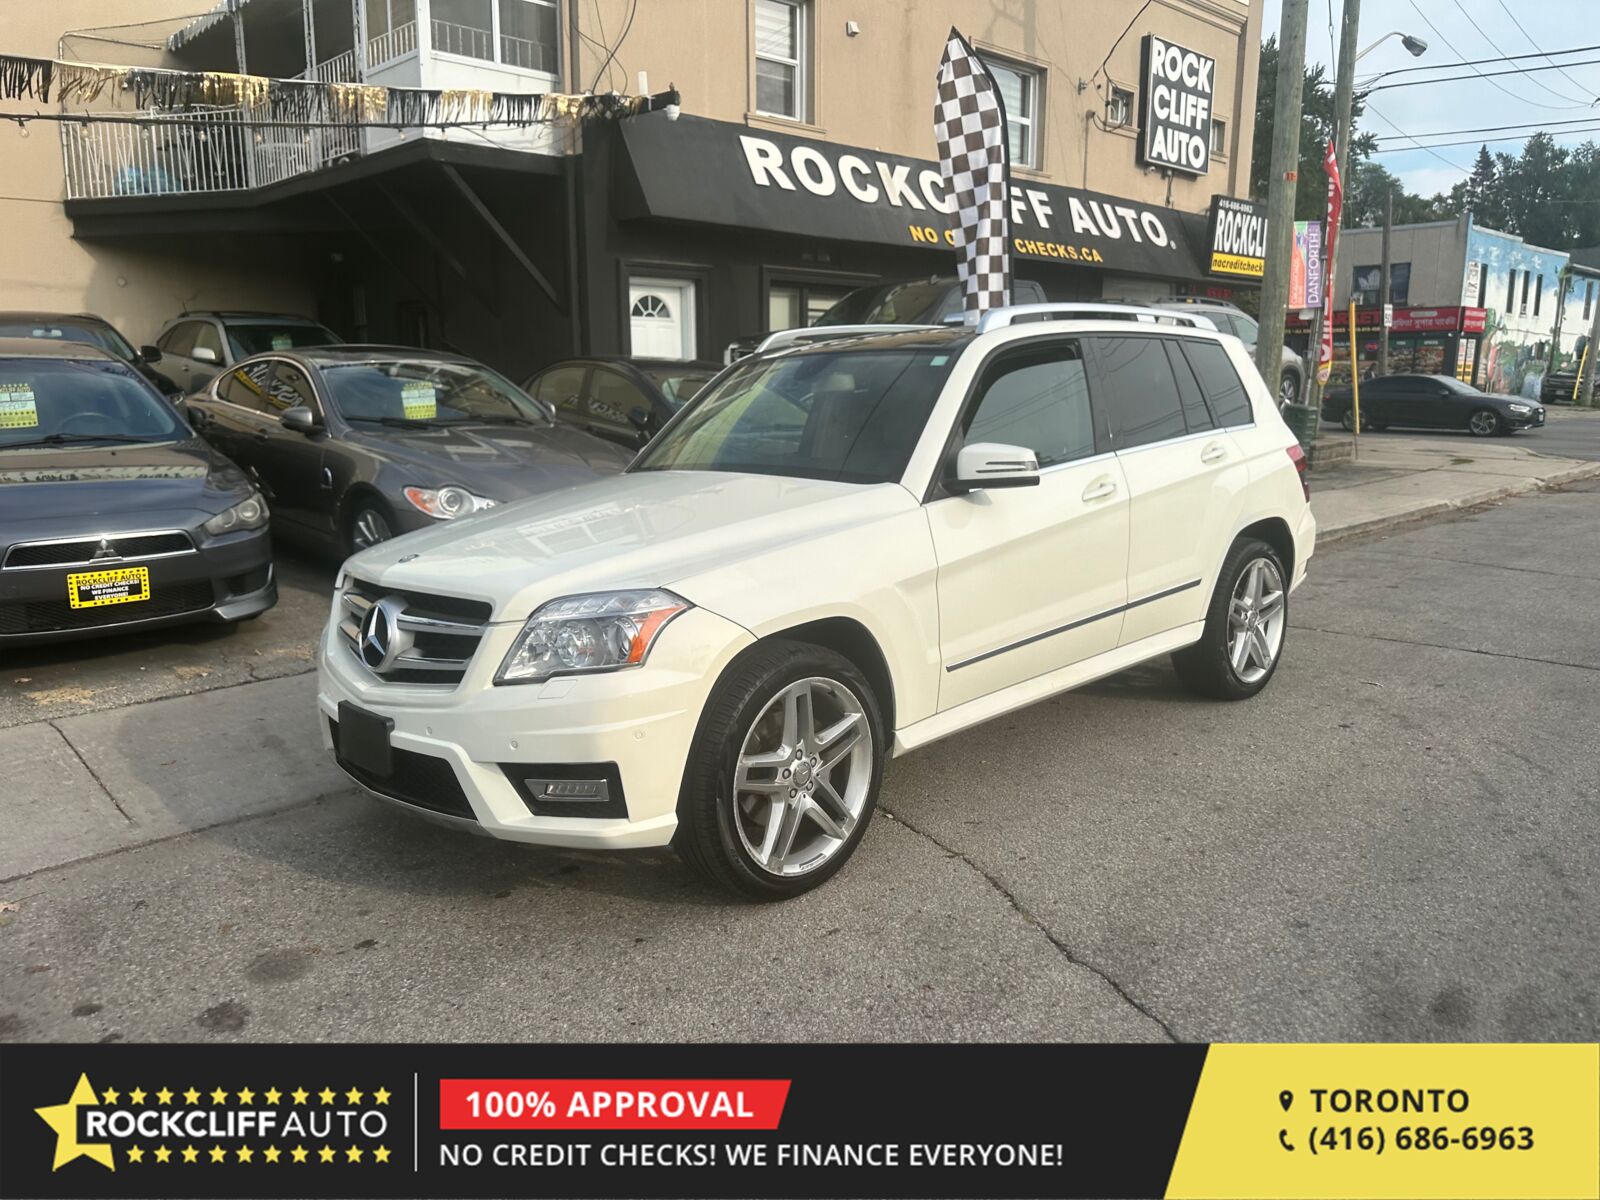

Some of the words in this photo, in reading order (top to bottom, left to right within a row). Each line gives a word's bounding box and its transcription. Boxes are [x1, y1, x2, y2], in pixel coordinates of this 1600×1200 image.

[1152, 38, 1213, 93] ROCK
[1154, 84, 1209, 130] CLIFF
[1151, 125, 1206, 169] AUTO
[738, 134, 1053, 229] ROCKCFF
[908, 225, 938, 244] NO
[1014, 238, 1104, 263] CHECKS.CA
[1214, 209, 1268, 258] ROCKCLI
[1212, 258, 1264, 273] nocreditcheck
[1308, 231, 1320, 304] DANFORTH
[76, 576, 118, 586] ROCKCLIFF
[121, 573, 141, 581] AUTO
[102, 586, 130, 594] FINANCE
